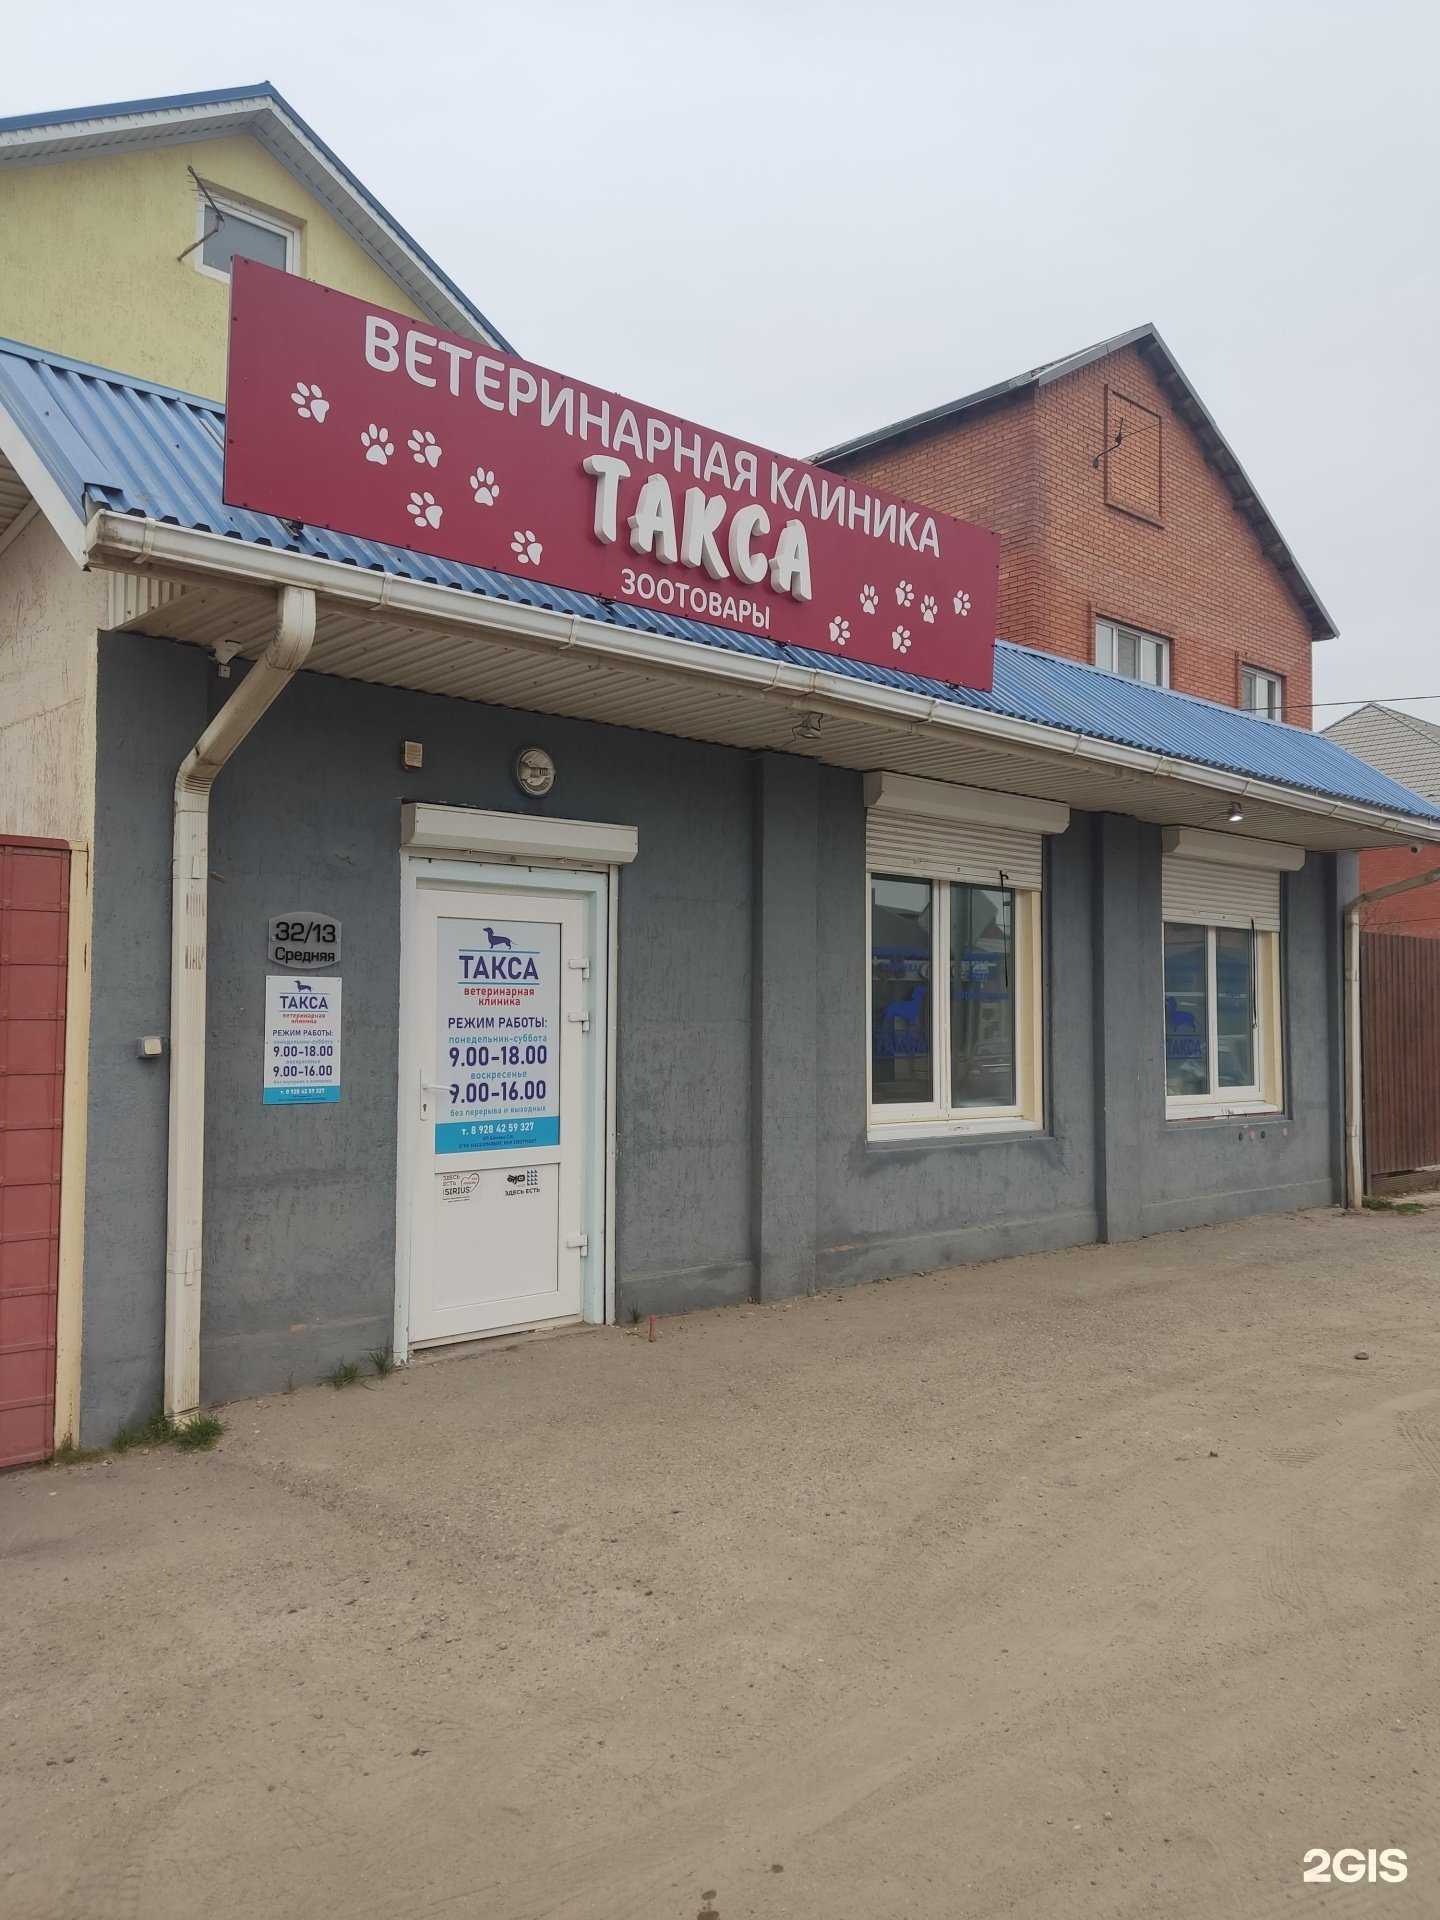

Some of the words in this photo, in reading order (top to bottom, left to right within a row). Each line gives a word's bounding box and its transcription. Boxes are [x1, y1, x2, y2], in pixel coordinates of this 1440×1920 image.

[365, 314, 758, 498] ВЕТЕРИНАРНАЯ
[770, 461, 940, 559] КЛИНИКА
[582, 454, 812, 602] ТАКСА
[620, 568, 770, 630] ЗООТОВАРЫ
[275, 921, 336, 944] 32/13
[274, 946, 335, 964] Средняя
[458, 955, 539, 980] ТАКСА
[464, 987, 535, 998] ветеринарная
[280, 995, 328, 1010] ТАКСА
[478, 997, 521, 1006] клиника
[448, 1016, 495, 1029] РЕЖИМ
[499, 1016, 548, 1029] РАБОТЫ:
[272, 1029, 301, 1037] РЕЖИМ
[303, 1029, 334, 1037] РАБОТЫ:
[273, 1045, 334, 1057] 9.00-18.00
[449, 1045, 548, 1068] 9.00-18.00
[273, 1065, 333, 1078] 9.00-16.00
[470, 1071, 528, 1081] воскресенье
[449, 1080, 547, 1104] 9.00-16.00
[520, 1121, 535, 1132] 327
[444, 1186, 471, 1196] SIRIUS
